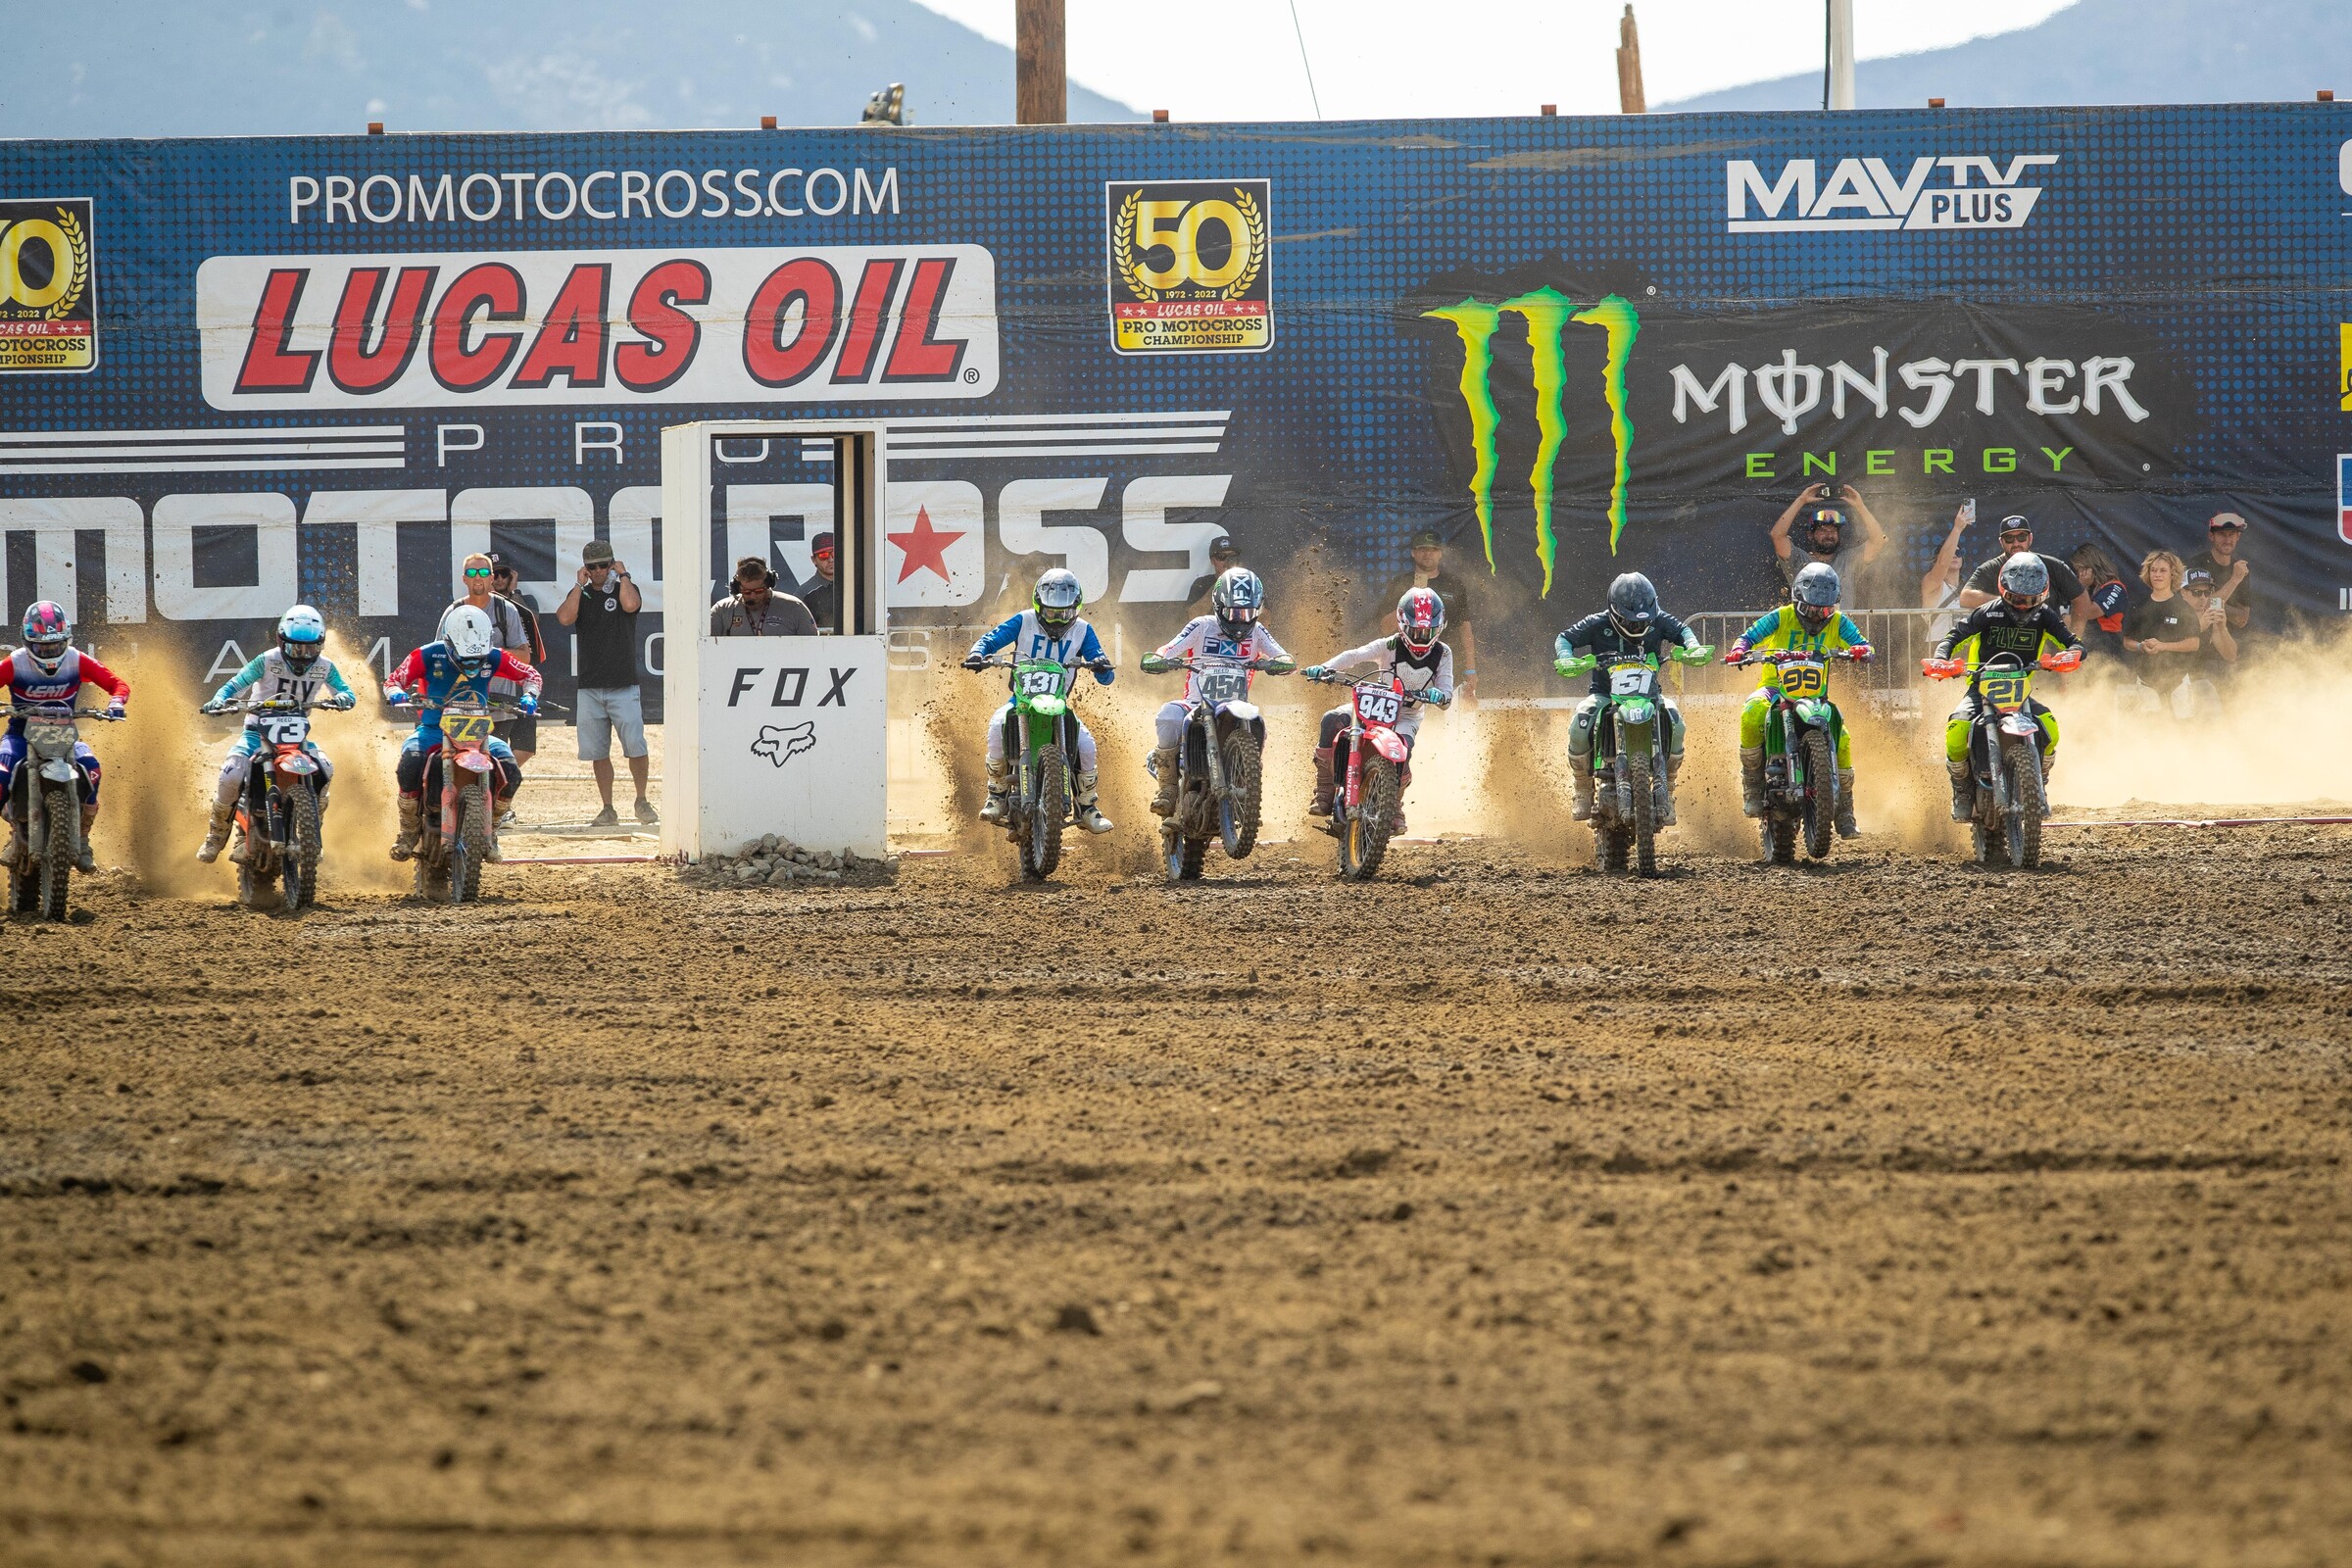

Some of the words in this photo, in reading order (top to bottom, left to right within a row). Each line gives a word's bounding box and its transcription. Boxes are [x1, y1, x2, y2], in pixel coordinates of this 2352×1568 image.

[289, 167, 901, 224] PROMOTOCROSS.COM
[1933, 192, 2013, 224] PLUS
[1131, 199, 1252, 290] 50
[1165, 290, 1187, 299] 1972
[1194, 290, 1217, 299] 2022
[17, 310, 40, 318] 2022
[1156, 304, 1201, 318] LUCAS
[1203, 303, 1226, 316] OIL
[26, 322, 50, 335] OIL
[233, 257, 711, 396] LUCAS
[741, 256, 969, 389] OIL
[1122, 320, 1156, 334] PRO
[1161, 318, 1263, 333] MOTOCROSS
[1143, 333, 1245, 346] CHAMPIONSHIP
[1668, 345, 2150, 436] MONSTER
[1744, 445, 2077, 478] ENERGY
[1031, 633, 1073, 663] FLY
[1986, 625, 2020, 649] FLY
[24, 682, 71, 698] LEATT
[727, 667, 858, 708] FOX
[1021, 671, 1060, 694] 131
[1201, 674, 1248, 700] 454
[1783, 668, 1821, 692] 99
[1986, 680, 2025, 704] 21
[1358, 694, 1398, 723] 943
[268, 722, 307, 744] 73
[449, 717, 492, 740] 74
[1345, 765, 1353, 803] DUNLOP
